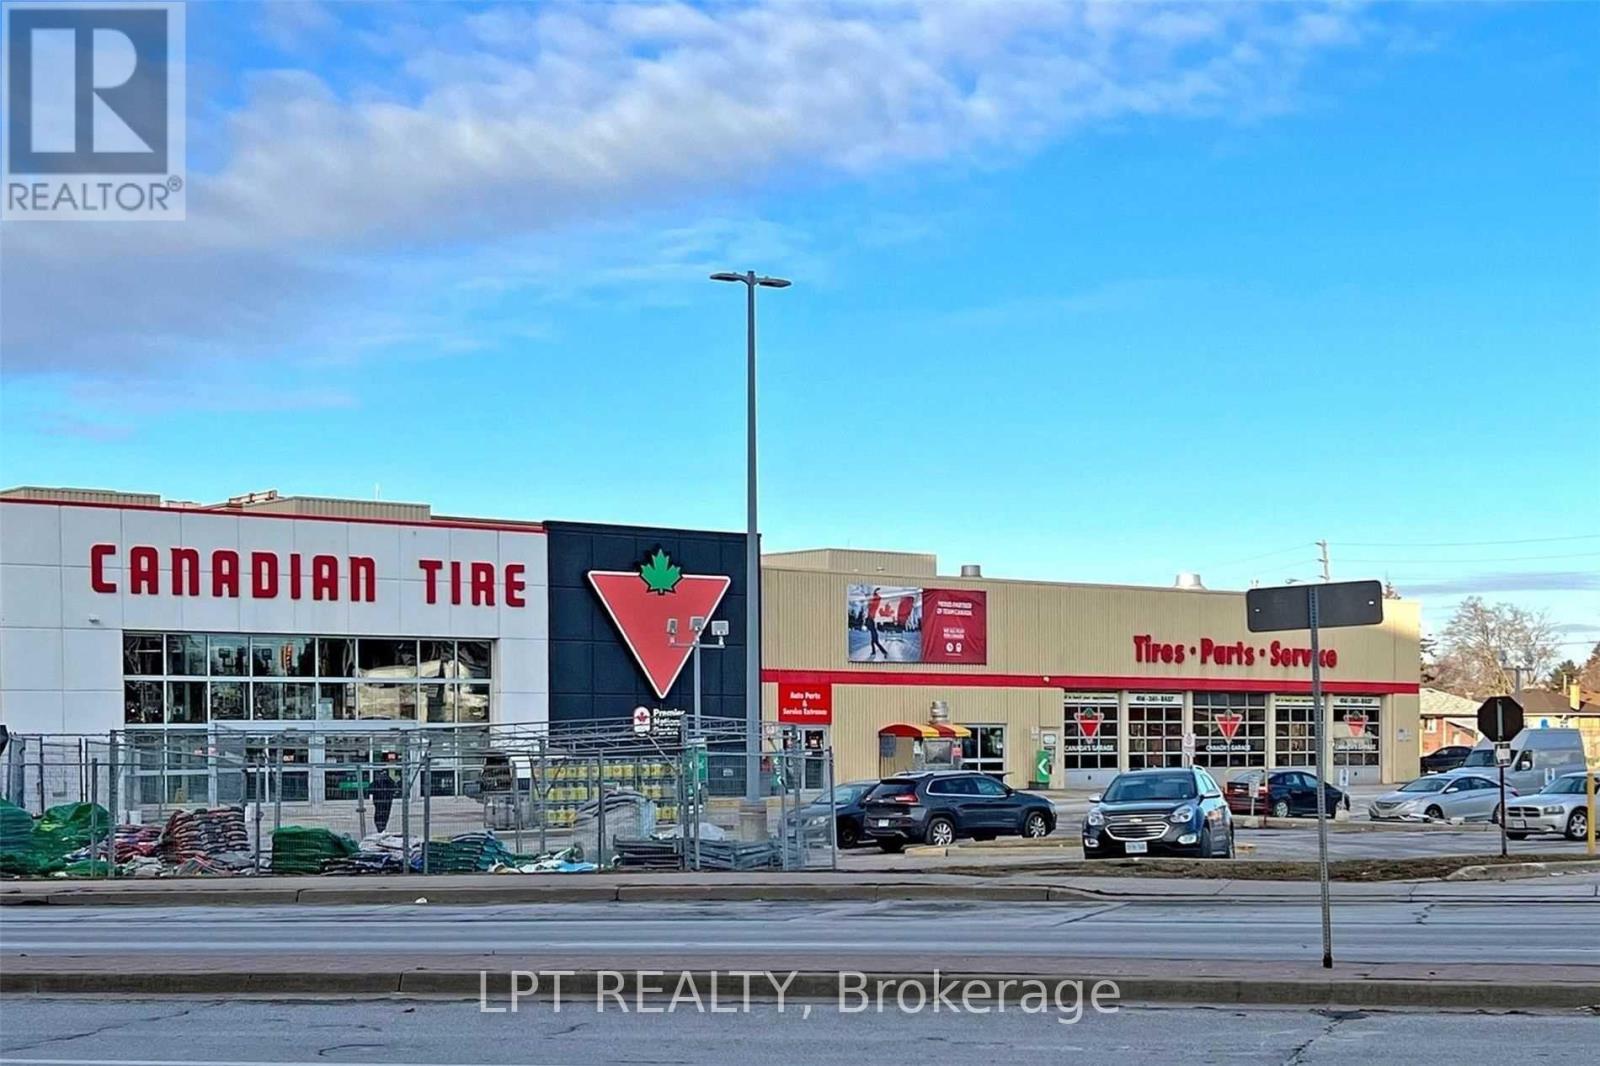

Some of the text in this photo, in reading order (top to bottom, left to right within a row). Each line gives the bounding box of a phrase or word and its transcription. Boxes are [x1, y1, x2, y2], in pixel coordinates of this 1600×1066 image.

[90, 544, 526, 607] CANADIAN TIRE
[1133, 634, 1338, 669] Tires Parts Servce
[804, 691, 821, 700] Parts
[652, 708, 686, 716] Premier
